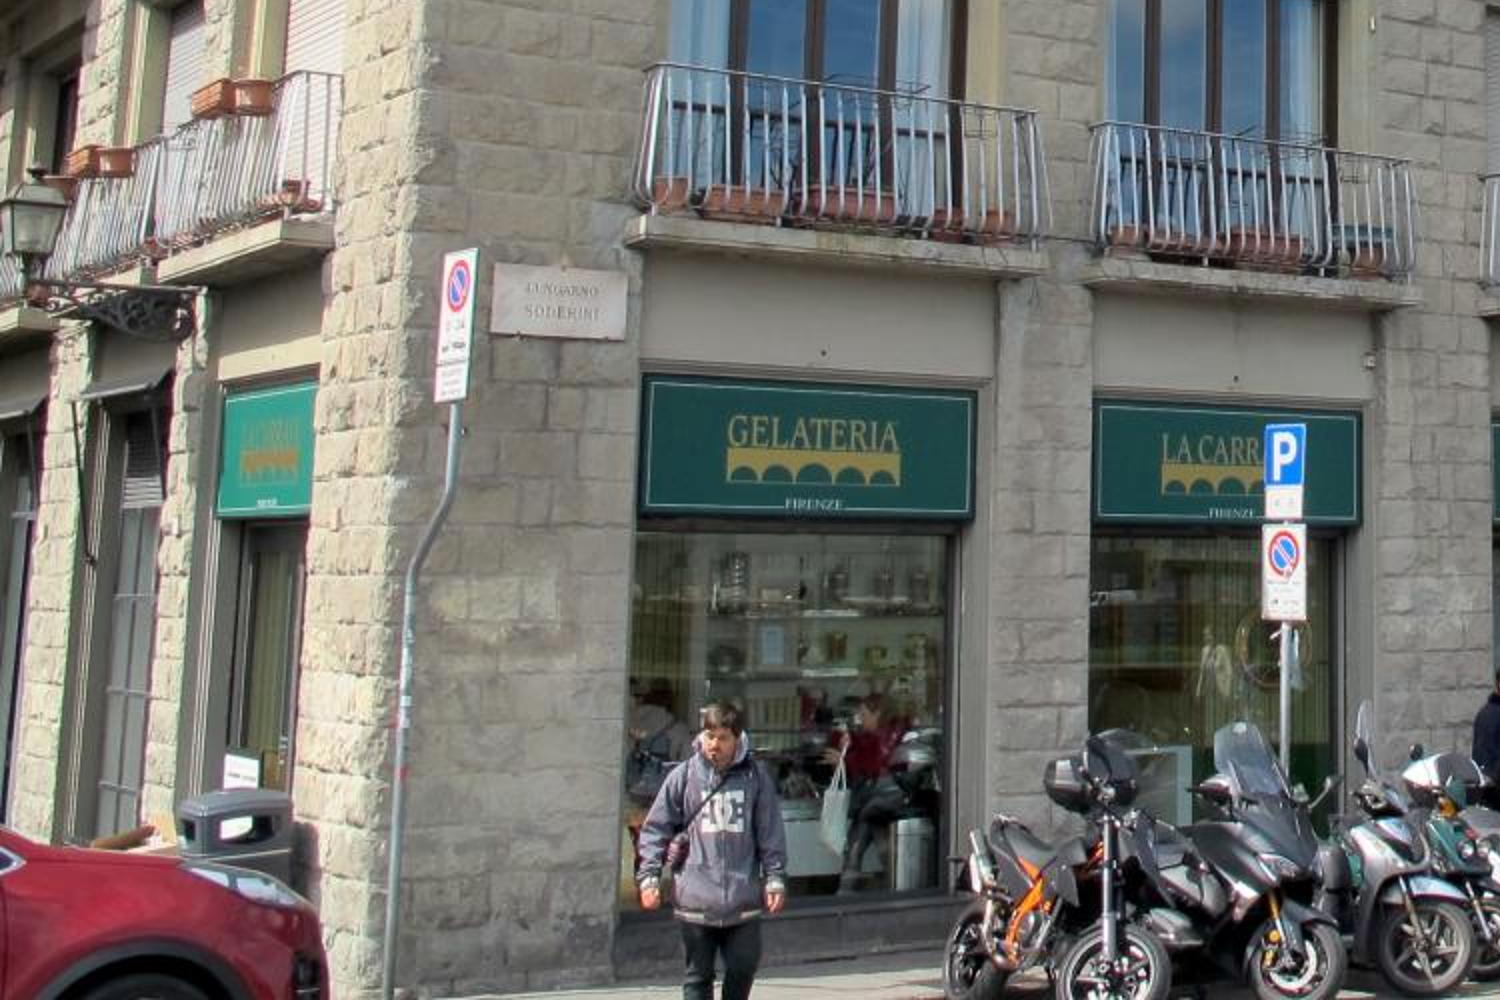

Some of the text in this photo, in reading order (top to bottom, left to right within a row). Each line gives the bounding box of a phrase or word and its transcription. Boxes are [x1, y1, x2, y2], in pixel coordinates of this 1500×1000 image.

[526, 281, 599, 297] LUNGARNO
[524, 304, 600, 322] SODERINI
[727, 414, 900, 452] GELATERIA
[1162, 433, 1264, 466] LA CARR
[1272, 431, 1297, 482] P
[784, 498, 843, 511] FIRENZE
[1208, 507, 1255, 519] FIRENZE
